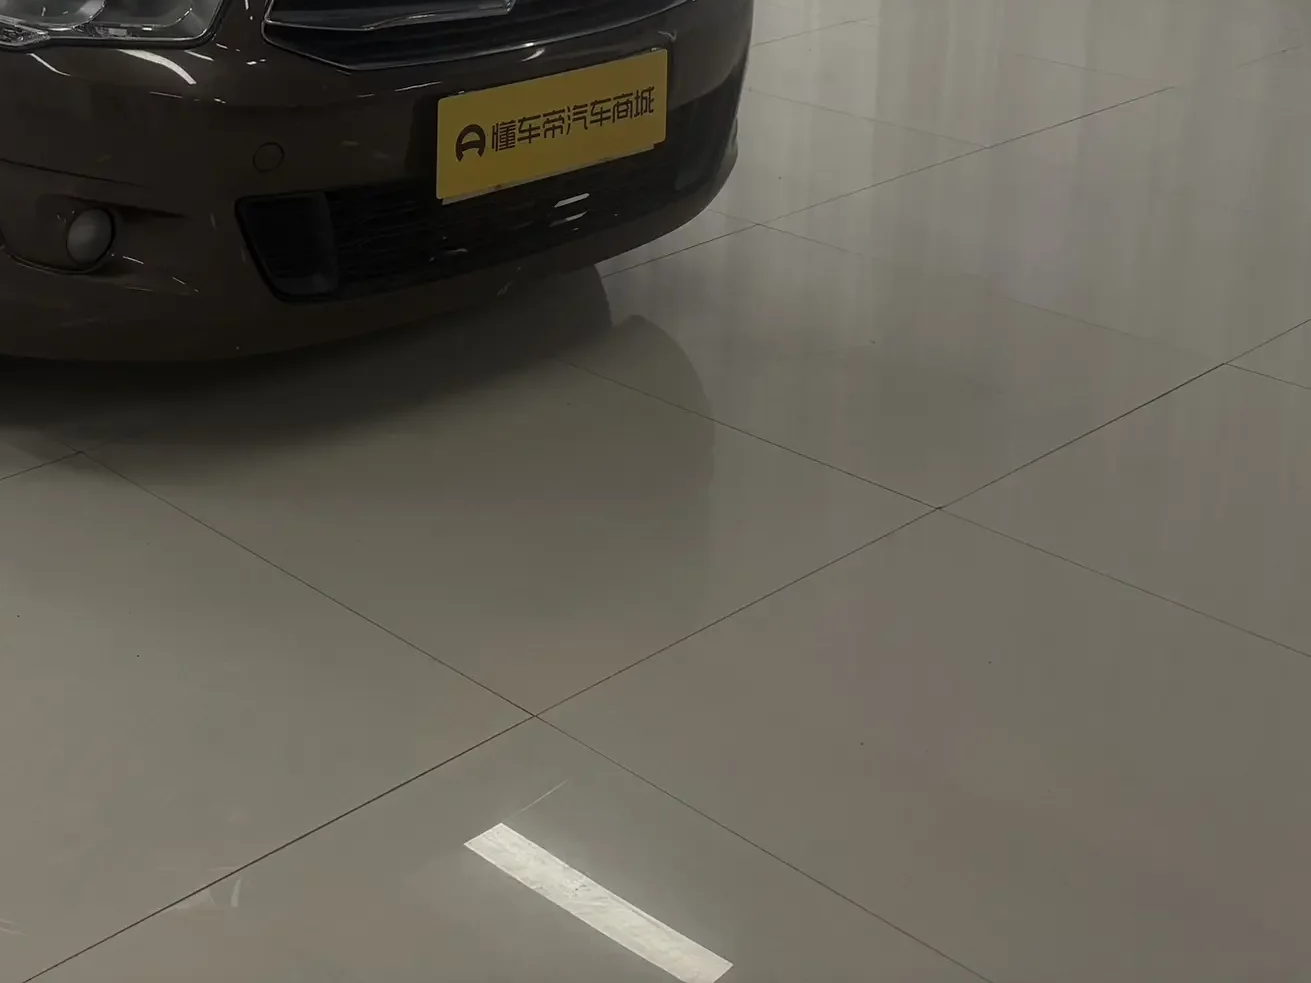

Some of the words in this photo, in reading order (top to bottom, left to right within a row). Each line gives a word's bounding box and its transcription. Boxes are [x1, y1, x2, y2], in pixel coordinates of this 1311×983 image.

[491, 86, 655, 152] 懂车帝汽车商城
